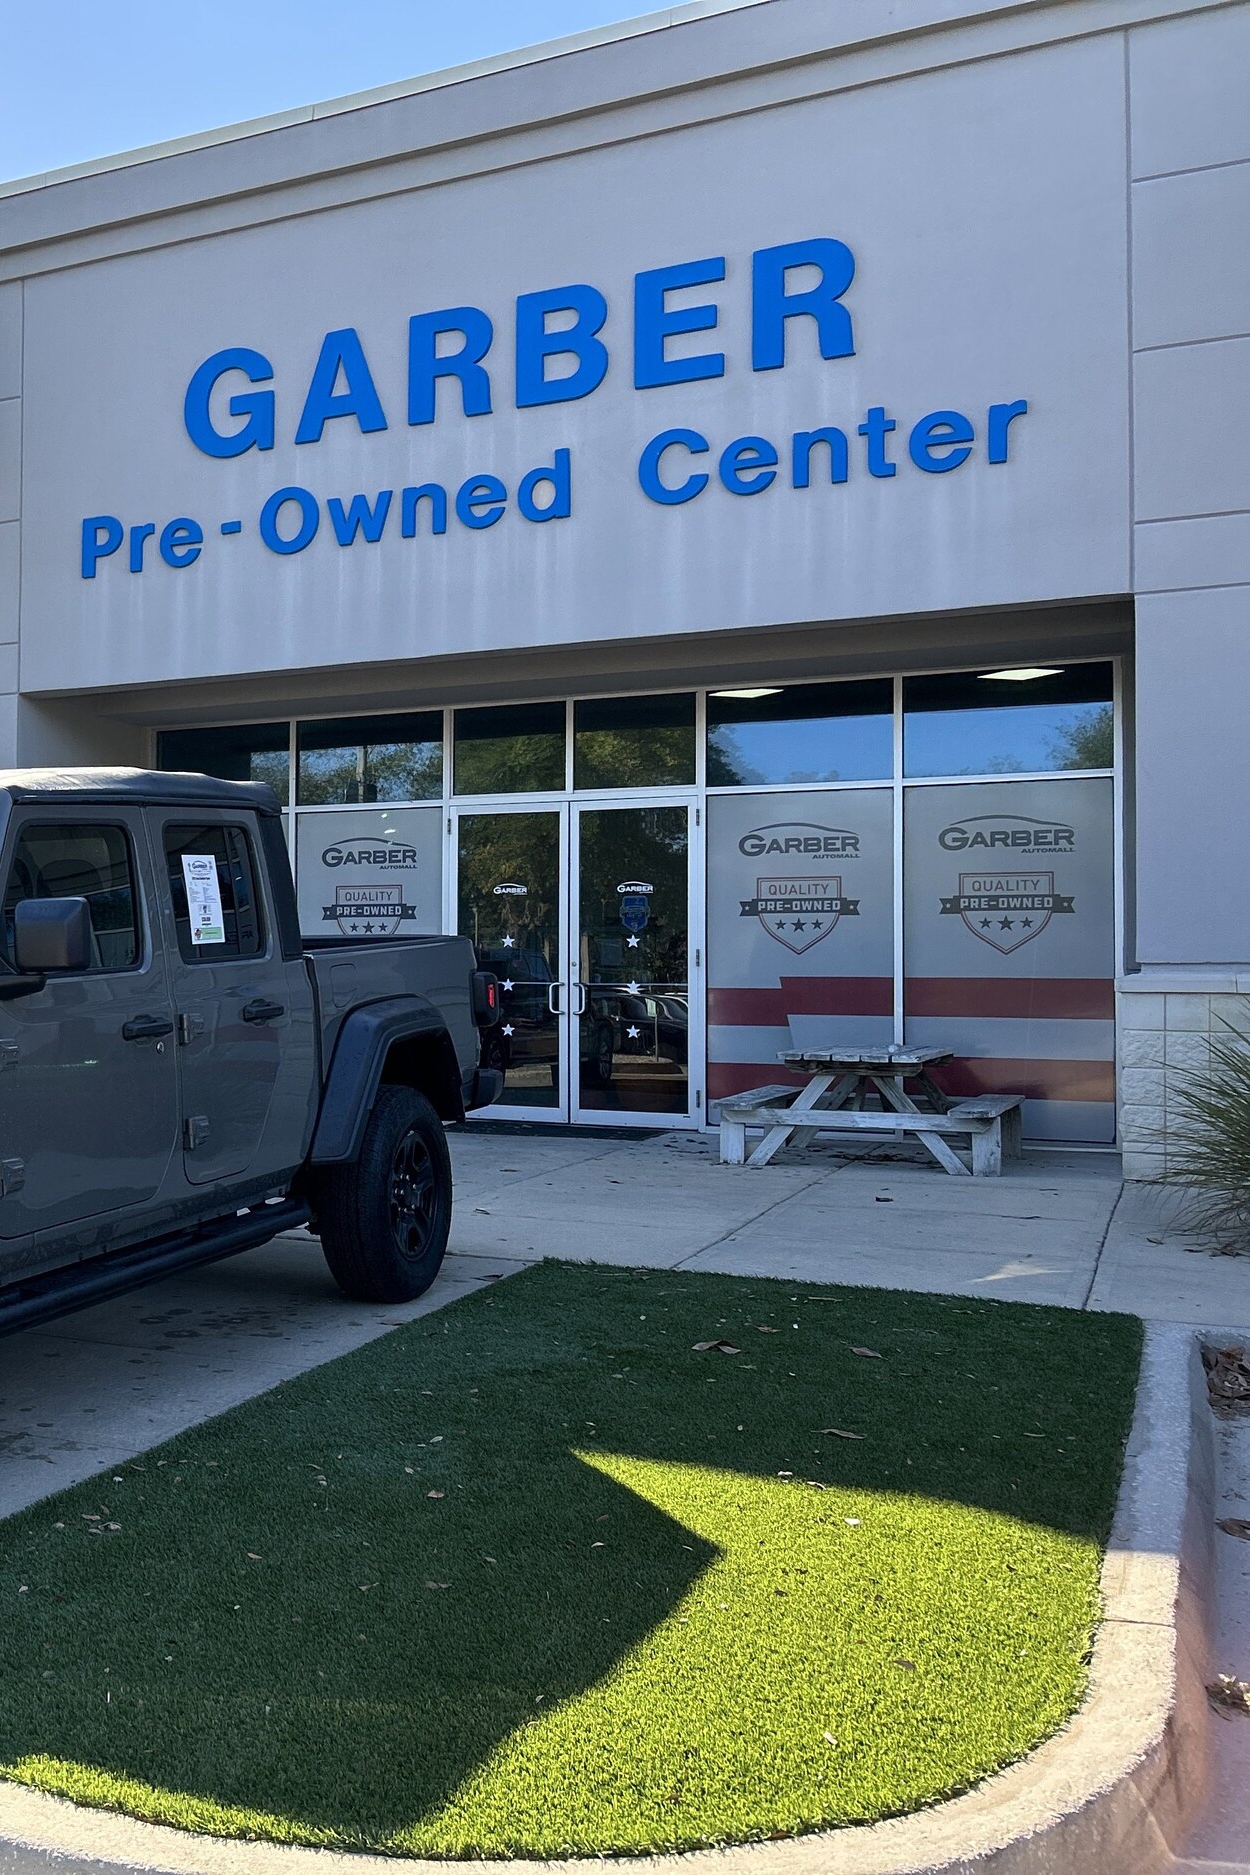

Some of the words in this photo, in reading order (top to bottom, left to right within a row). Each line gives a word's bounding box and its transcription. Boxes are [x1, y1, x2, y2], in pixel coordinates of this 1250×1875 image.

[184, 236, 856, 459] GARBER
[81, 448, 571, 579] Pre-Owned
[638, 399, 1028, 506] Center
[738, 834, 860, 857] GARBER
[938, 827, 1075, 851] GARBER
[322, 847, 417, 867] GARBER
[493, 886, 528, 895] GARBER
[617, 884, 654, 893] GARBER
[768, 883, 829, 895] QUALITY
[972, 879, 1040, 892] QUALITY
[345, 891, 393, 902] QUALITY
[960, 896, 1053, 909] PRE-OWNED
[336, 905, 402, 916] PRE-OWNED
[757, 900, 841, 911] PRE-OWNED
